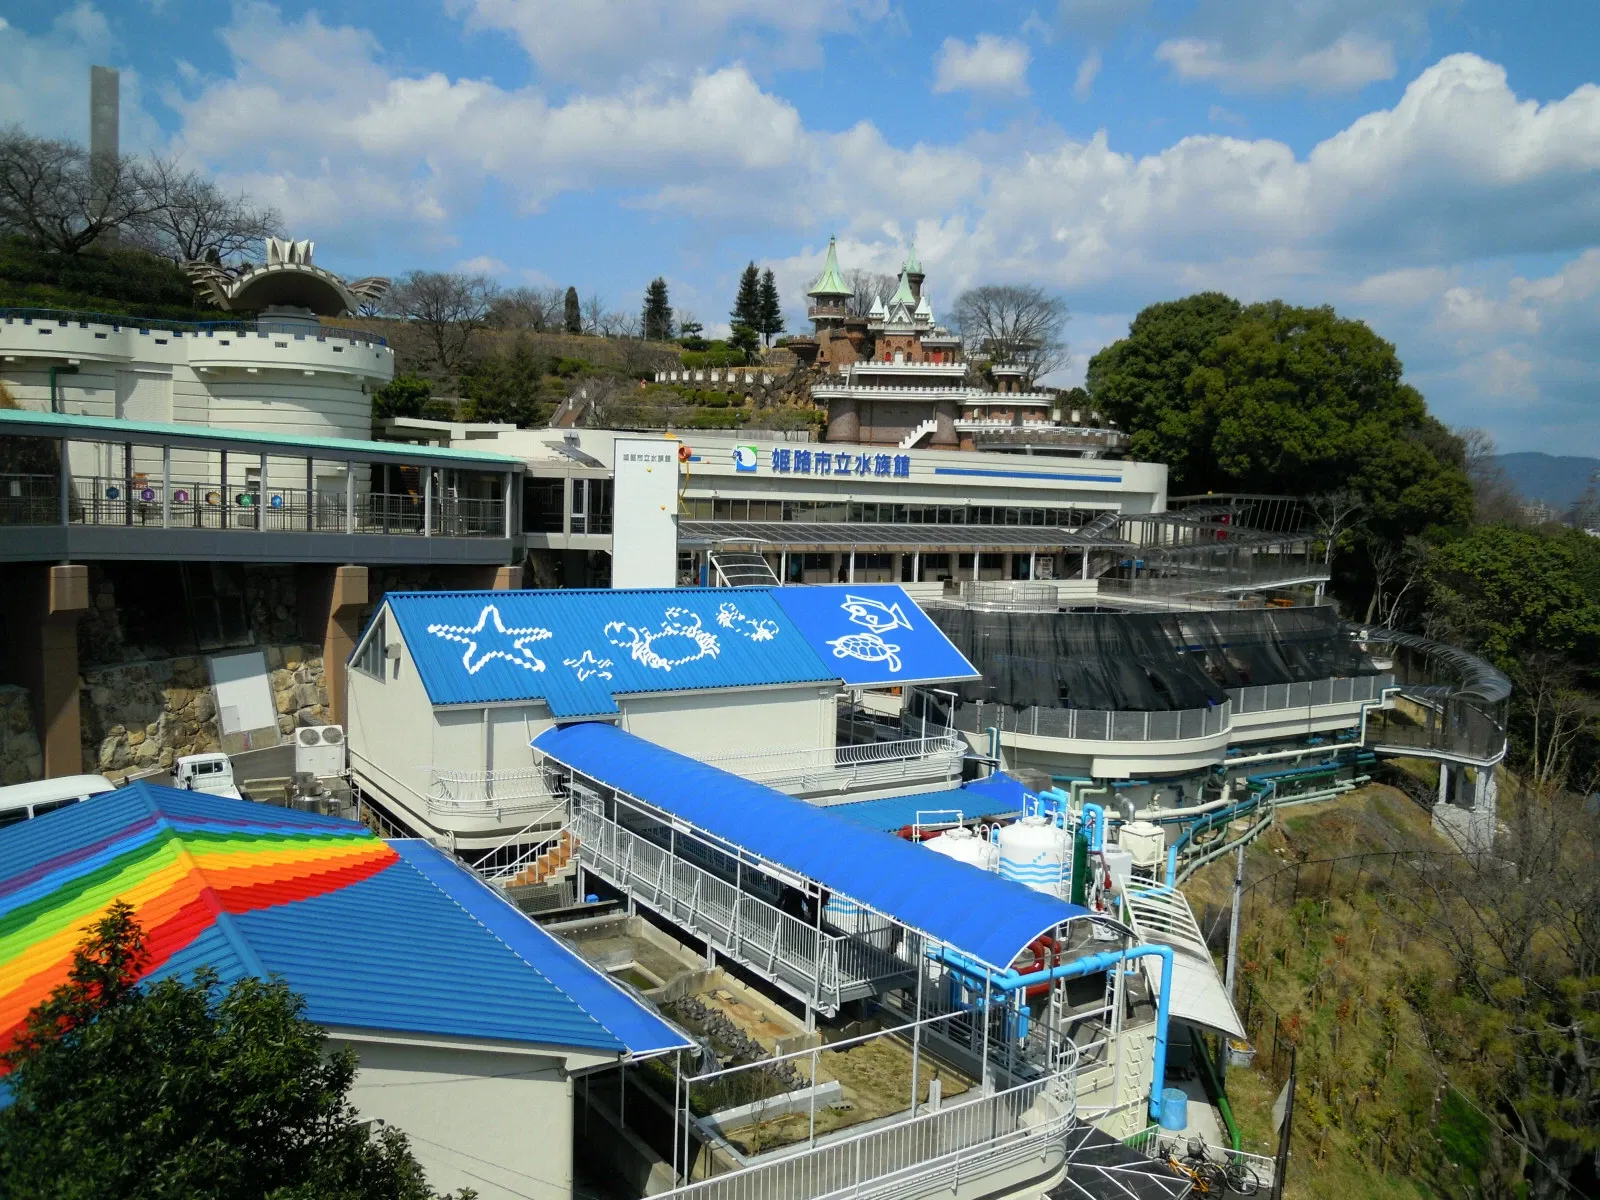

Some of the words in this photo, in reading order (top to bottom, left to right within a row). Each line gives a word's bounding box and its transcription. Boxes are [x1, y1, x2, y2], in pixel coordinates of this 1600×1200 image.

[771, 447, 910, 478] 姫路市立水族館
